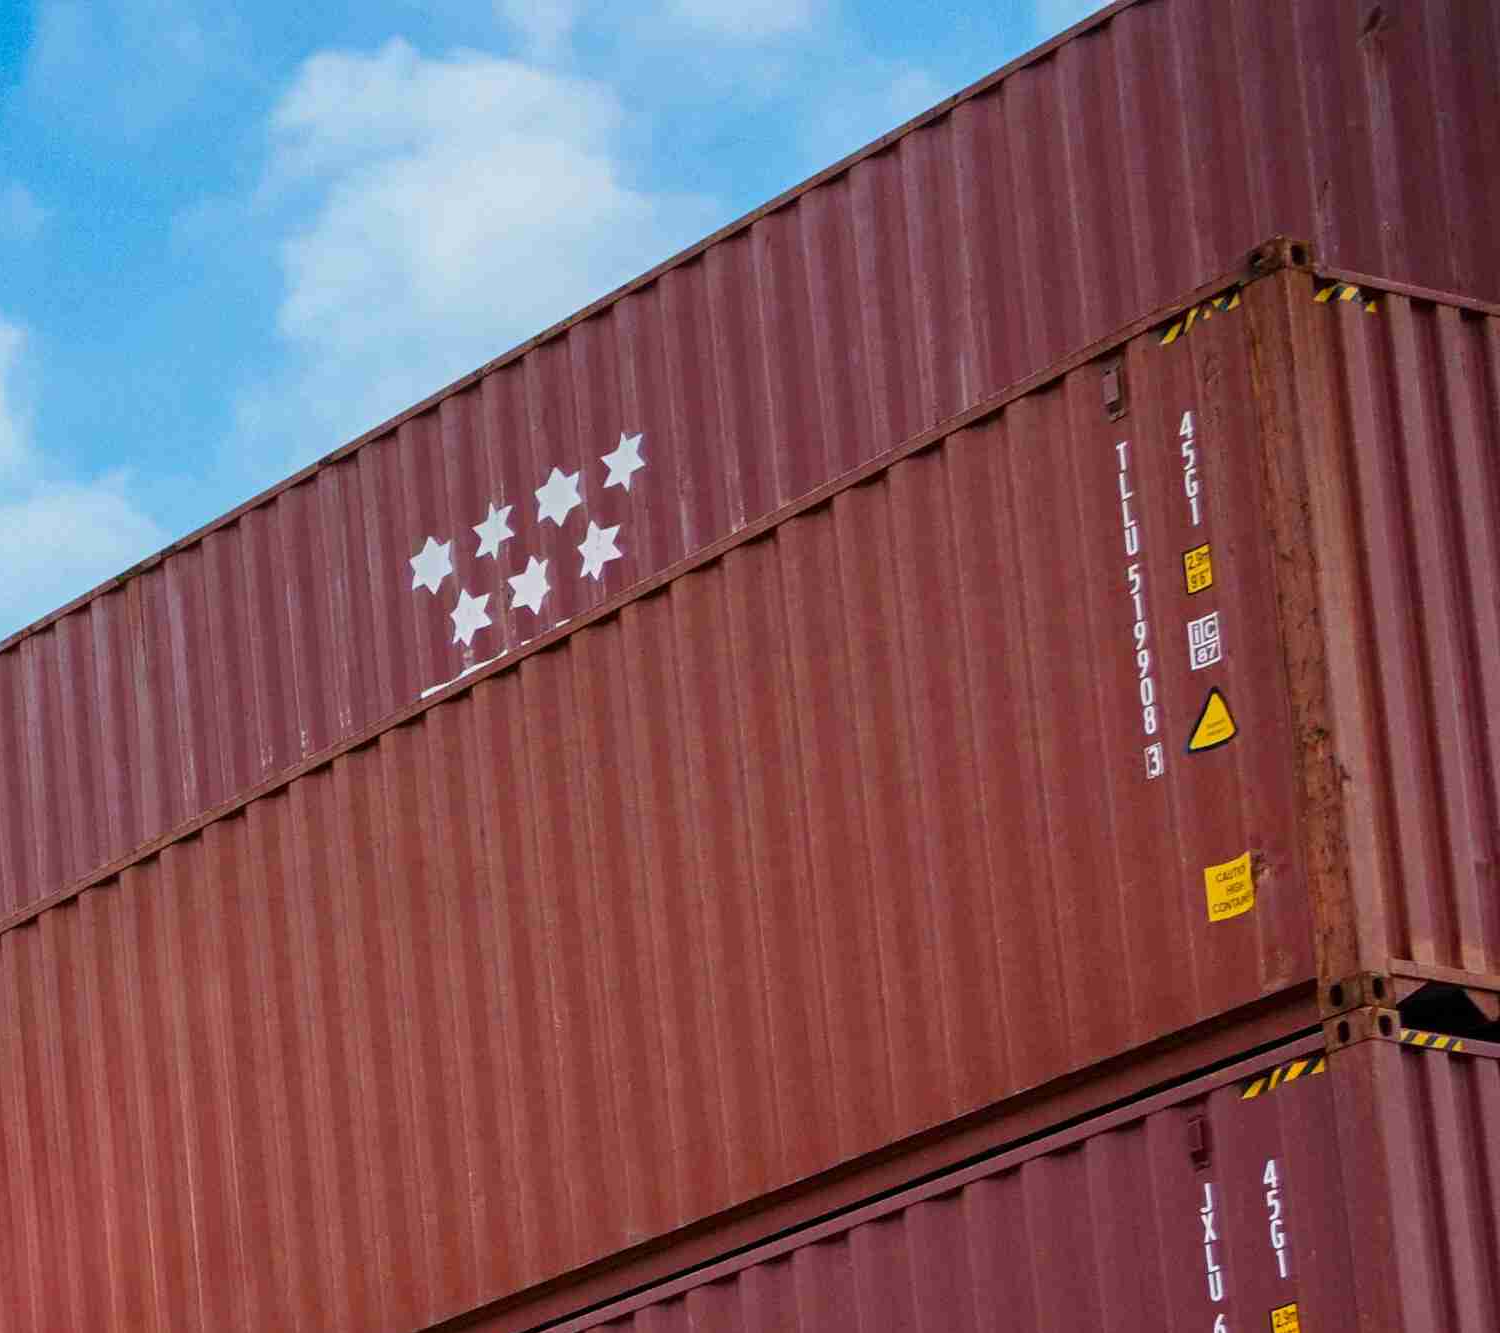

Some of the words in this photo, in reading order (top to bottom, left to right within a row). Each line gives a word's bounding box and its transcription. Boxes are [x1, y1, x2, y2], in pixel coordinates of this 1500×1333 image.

[1115, 441, 1140, 556] TLLU
[1179, 410, 1202, 526] 45G1
[1127, 564, 1157, 735] 519908
[1199, 1183, 1224, 1302] JXLU
[1262, 1159, 1287, 1278] 45G1
